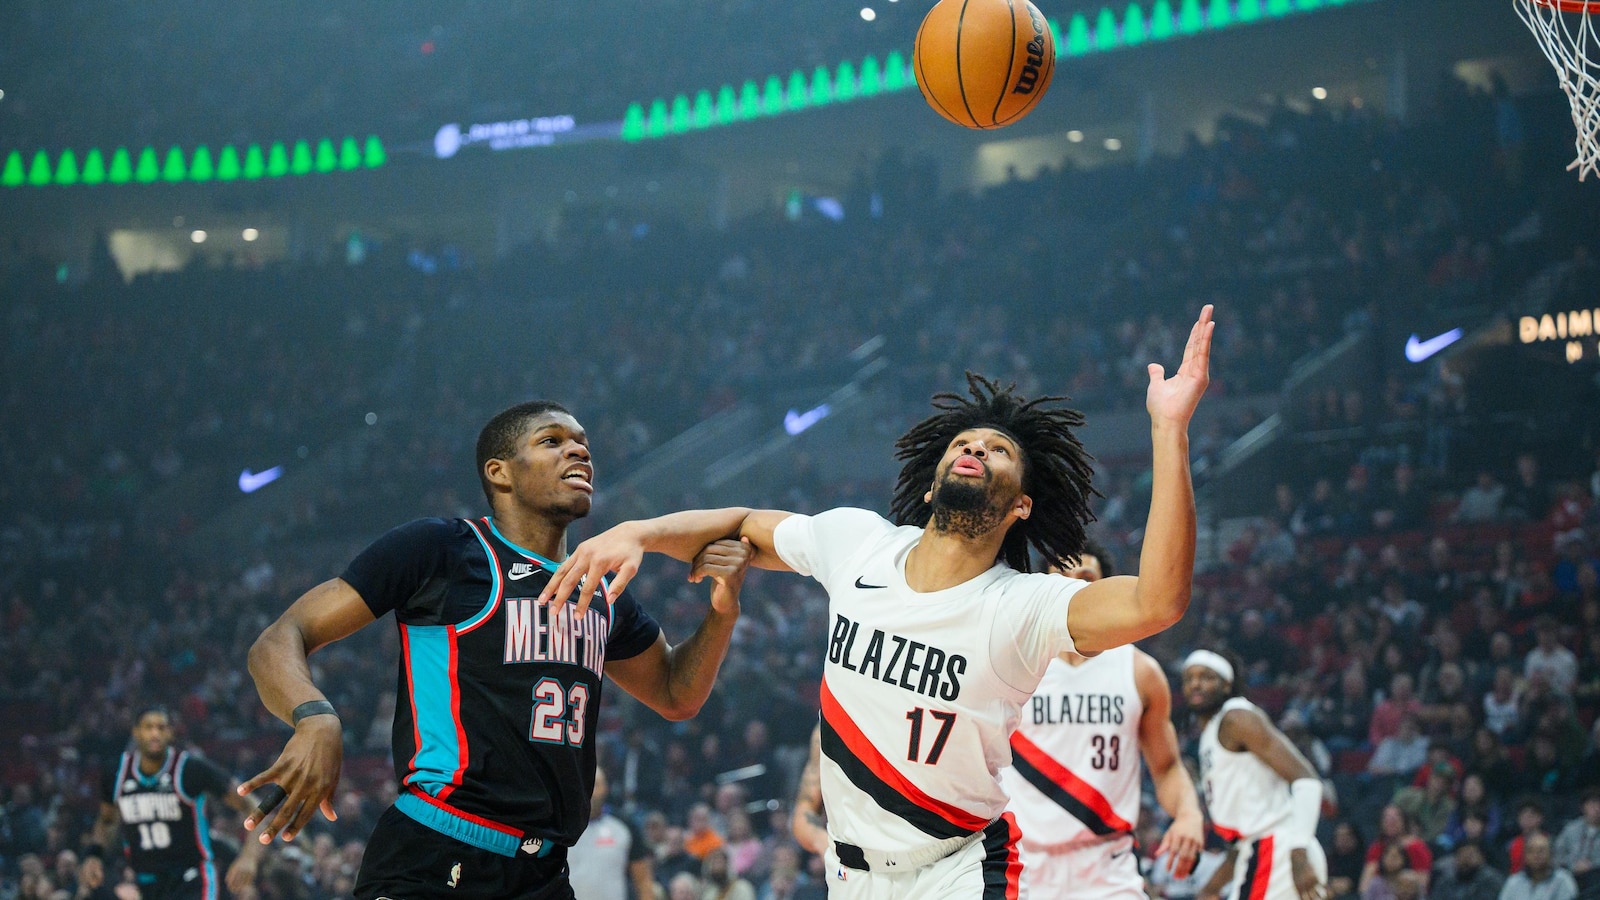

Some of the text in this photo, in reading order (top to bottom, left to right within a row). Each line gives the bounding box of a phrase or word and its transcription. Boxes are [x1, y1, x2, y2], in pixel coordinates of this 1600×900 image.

[1012, 4, 1045, 95] Wilson
[511, 562, 534, 574] NIKE
[828, 613, 967, 702] BLAZERS
[529, 676, 590, 749] 23
[906, 706, 957, 766] 17
[1032, 694, 1125, 725] BLAZERS
[1091, 735, 1119, 771] 33
